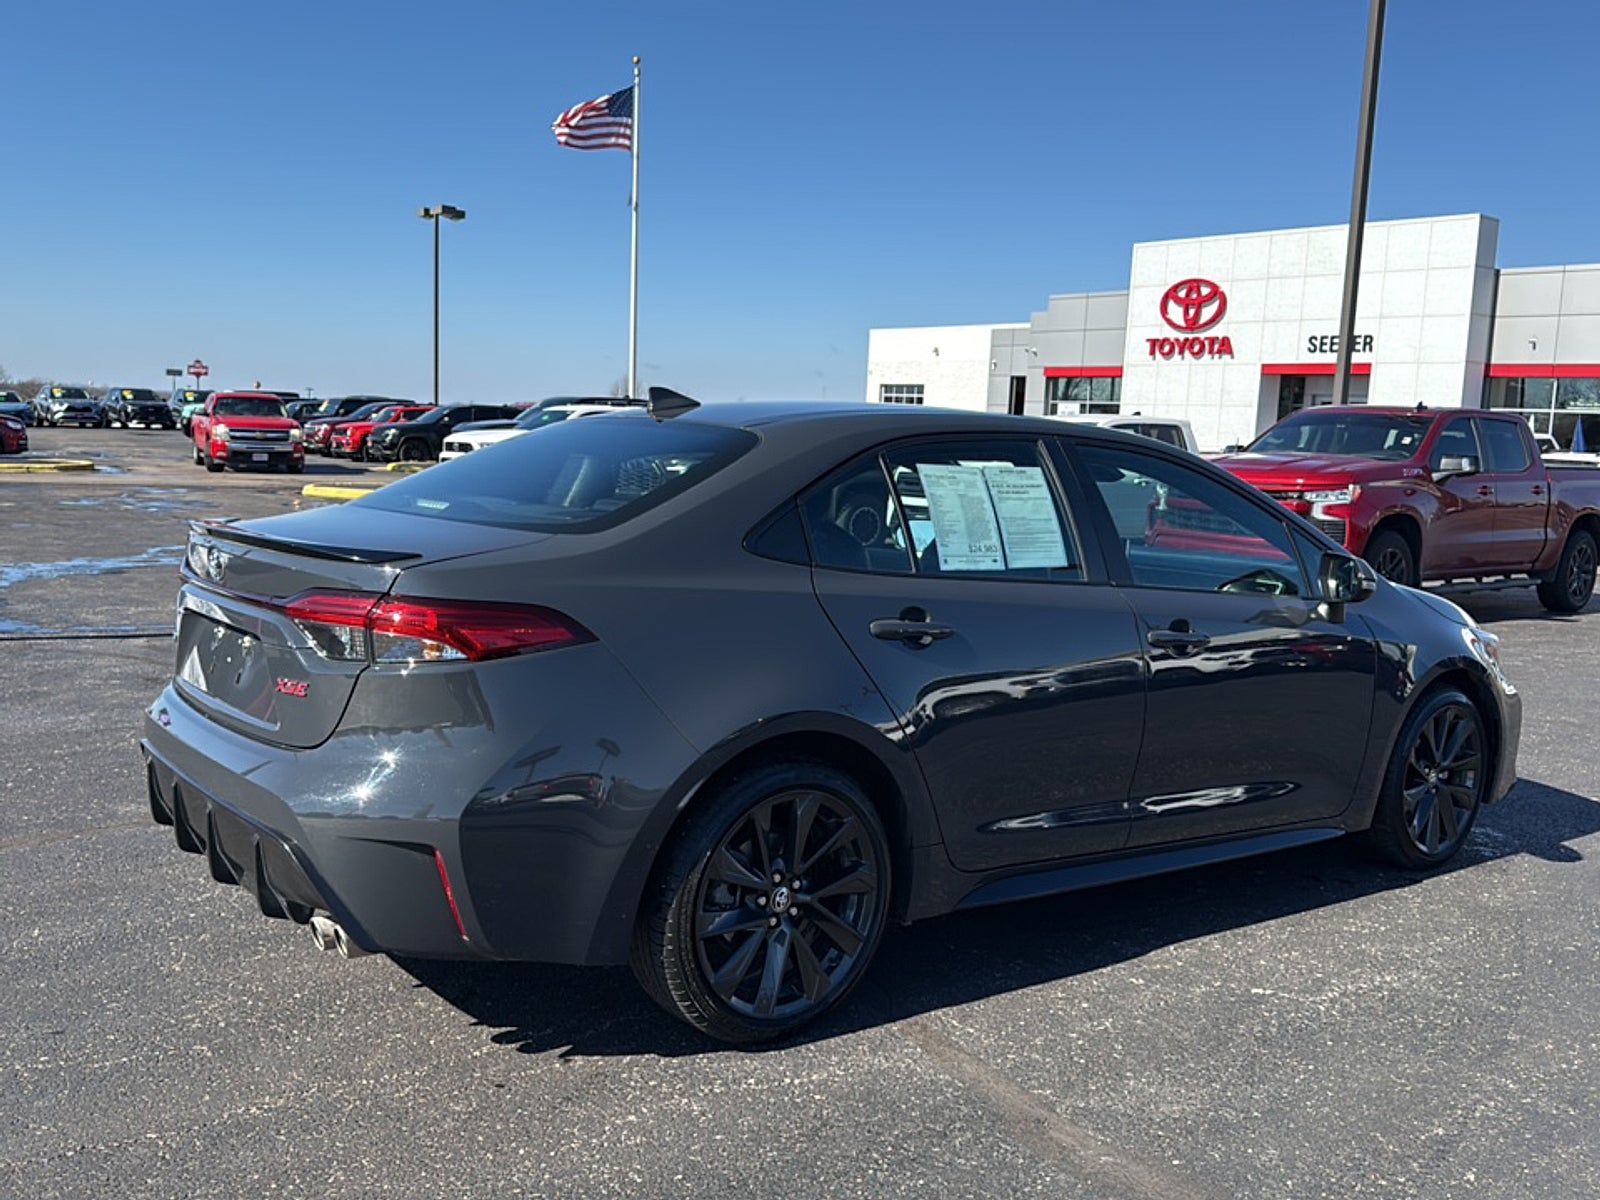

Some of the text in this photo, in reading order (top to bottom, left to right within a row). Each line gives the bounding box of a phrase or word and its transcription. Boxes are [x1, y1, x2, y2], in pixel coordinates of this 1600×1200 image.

[1145, 336, 1234, 360] TOYOTA
[1307, 334, 1374, 353] SEEER
[275, 678, 309, 698] XSE
